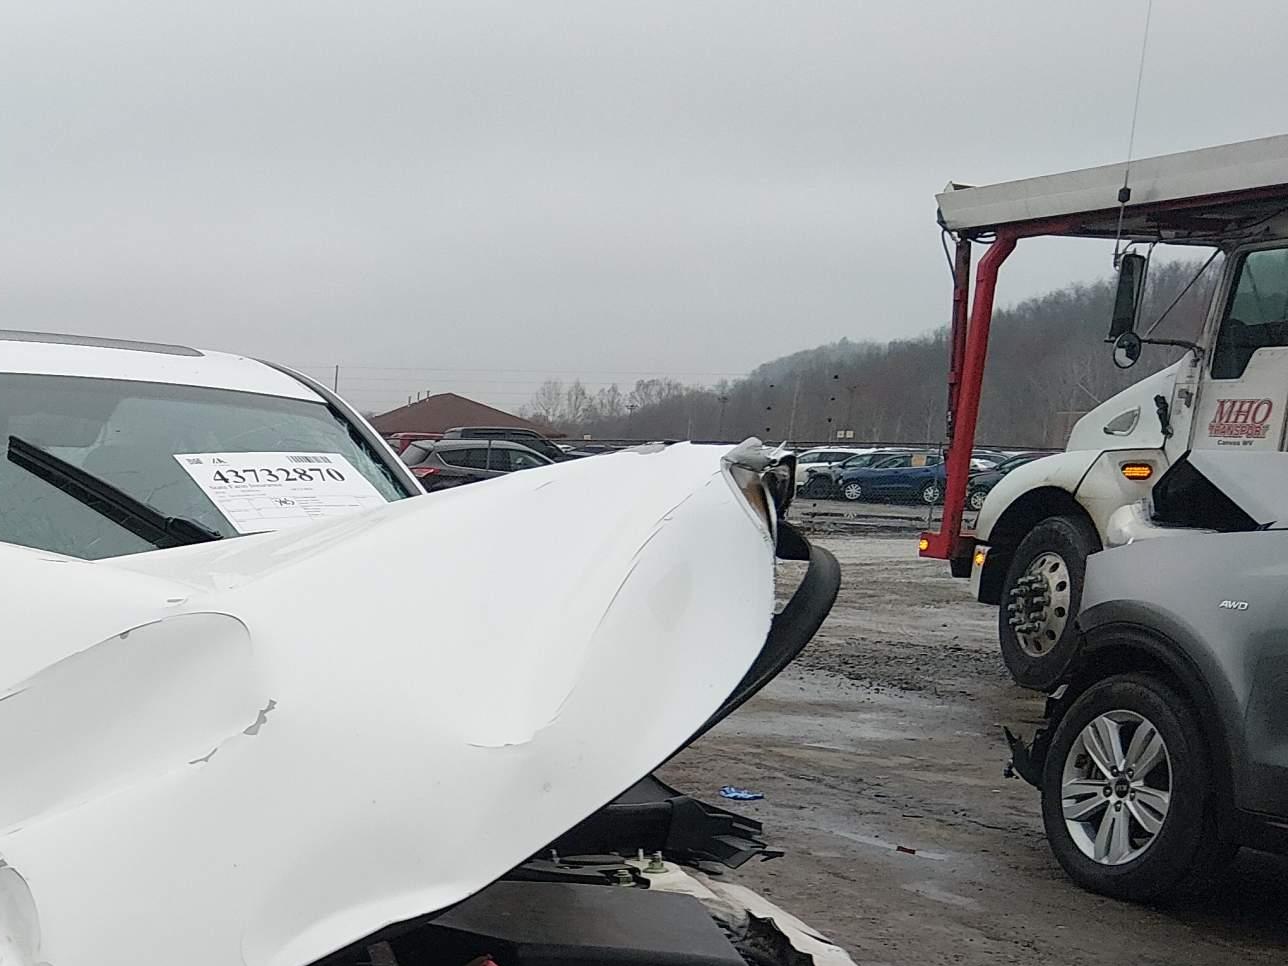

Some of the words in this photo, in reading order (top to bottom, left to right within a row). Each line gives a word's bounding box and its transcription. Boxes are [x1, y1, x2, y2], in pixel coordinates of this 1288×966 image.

[1211, 398, 1273, 424] MHO
[1208, 424, 1271, 438] TRANSPORT
[213, 467, 346, 485] 43732870
[1219, 600, 1250, 610] AWD
